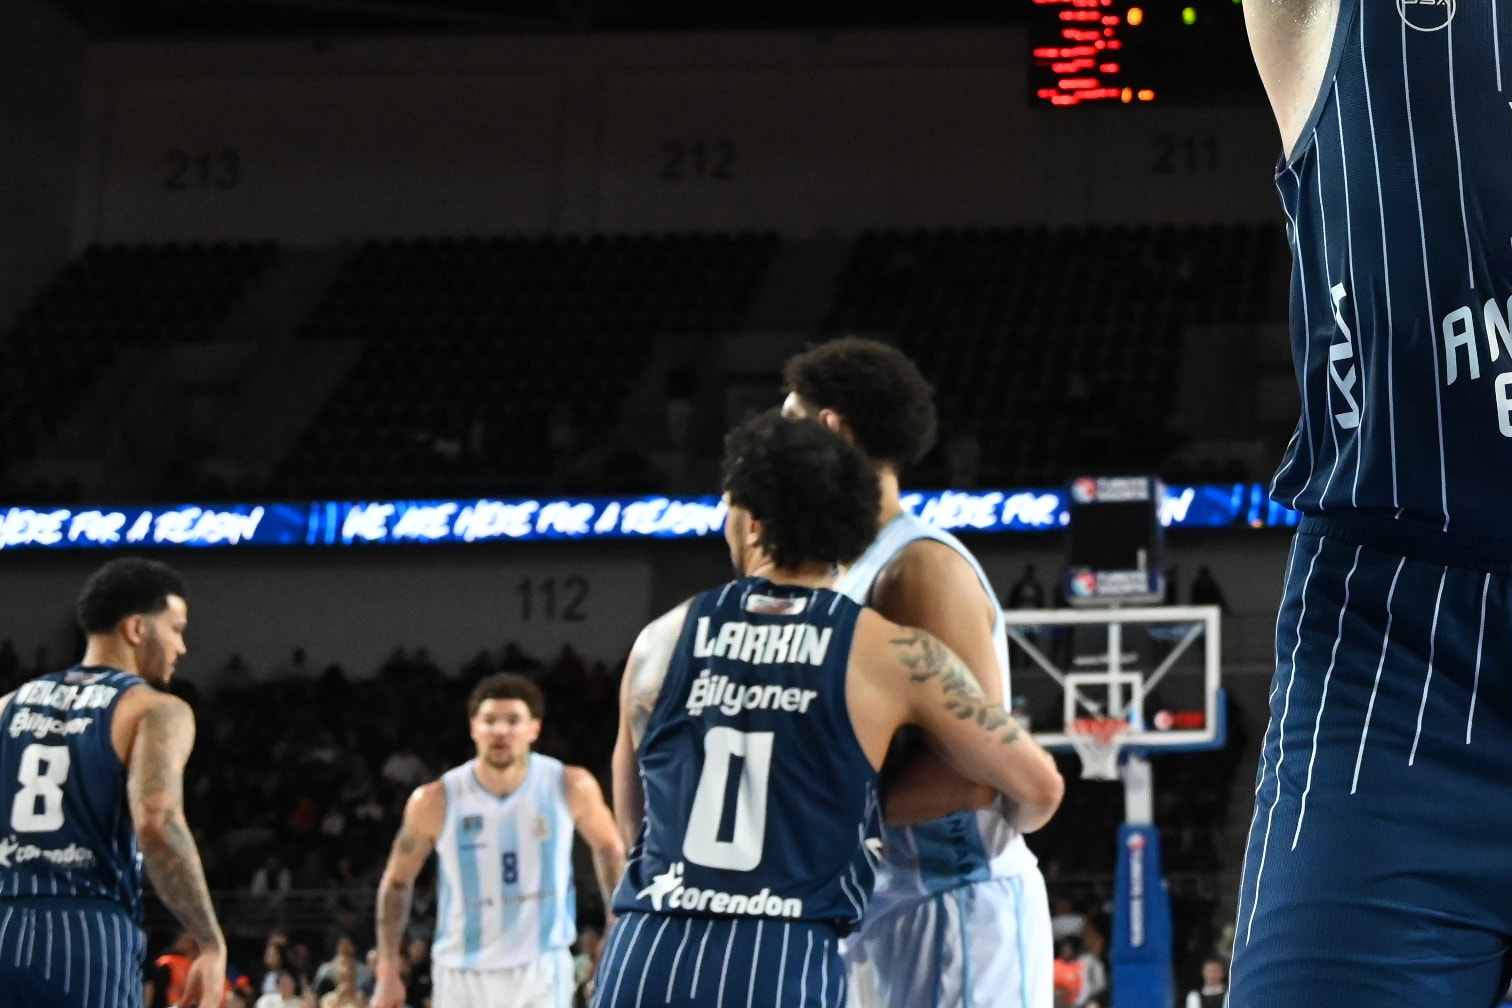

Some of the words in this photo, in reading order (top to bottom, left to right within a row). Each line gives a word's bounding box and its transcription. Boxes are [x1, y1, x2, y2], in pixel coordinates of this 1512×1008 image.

[163, 149, 241, 190] 213
[659, 140, 737, 181] 212
[1150, 134, 1218, 174] 211
[514, 575, 590, 621] 112
[693, 616, 833, 666] LARKIN
[686, 669, 818, 716] Bilyoner
[10, 743, 71, 832] 8
[682, 726, 775, 872] 0
[502, 851, 519, 885] 8
[668, 888, 803, 918] corendon
